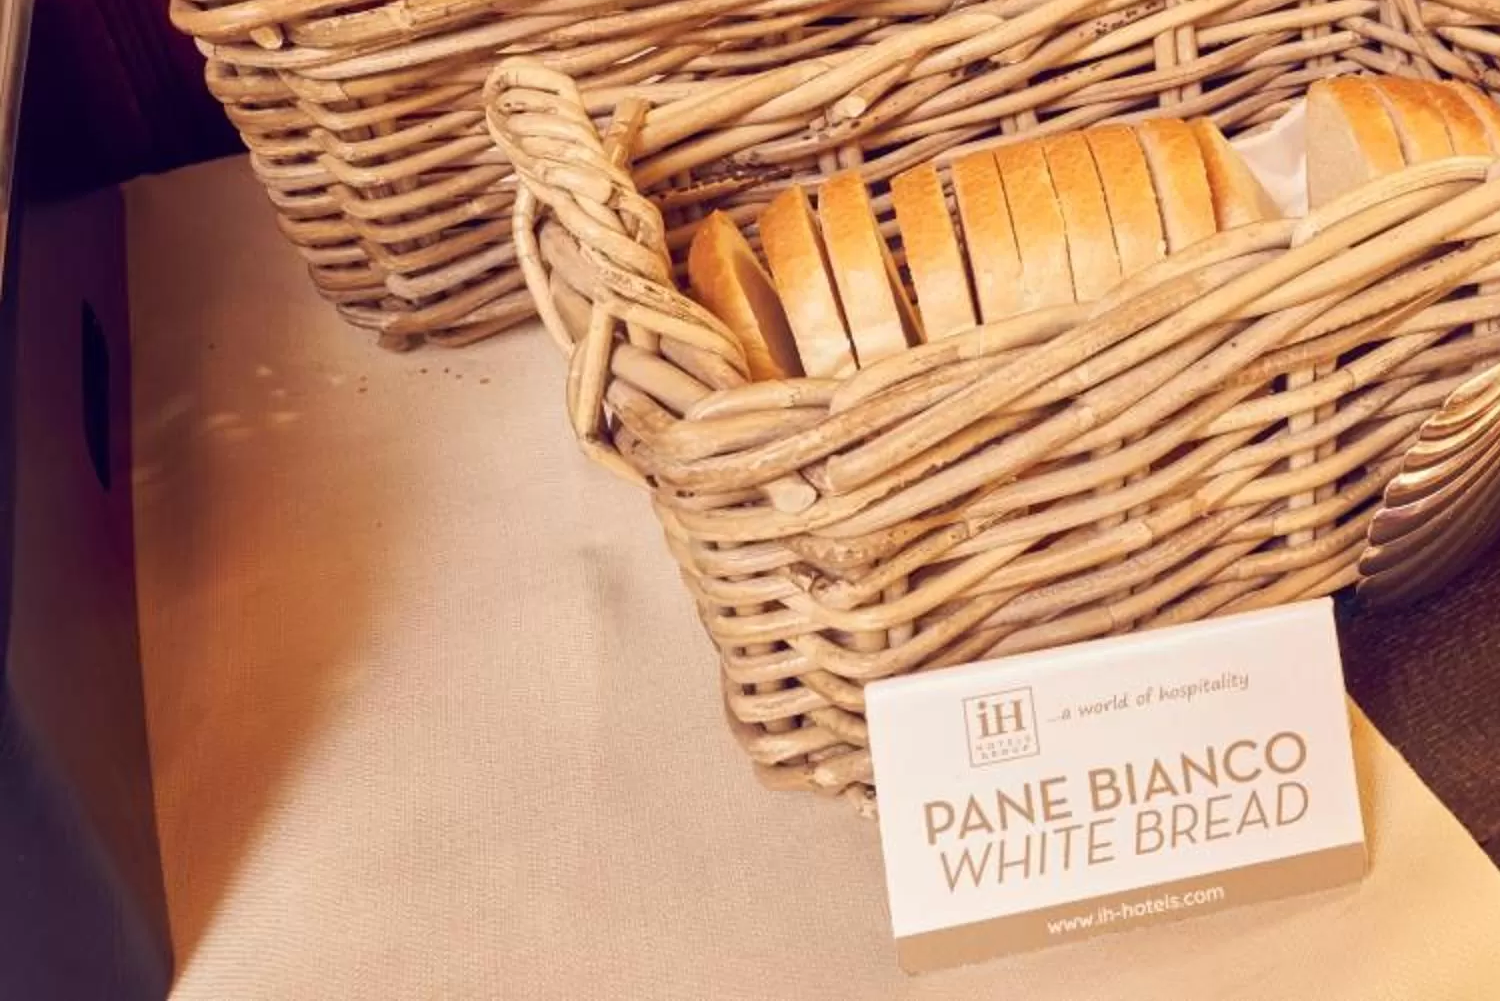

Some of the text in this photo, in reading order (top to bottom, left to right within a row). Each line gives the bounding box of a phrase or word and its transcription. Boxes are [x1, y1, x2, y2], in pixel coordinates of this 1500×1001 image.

[975, 699, 1027, 739] iH
[1077, 691, 1130, 719] world
[1135, 686, 1155, 708] of
[1159, 671, 1250, 703] hospitality
[922, 730, 1308, 846] PANE BIANCO
[939, 781, 1310, 894] WHITE BREAD
[1047, 885, 1226, 935] www.ih-hotels.com
